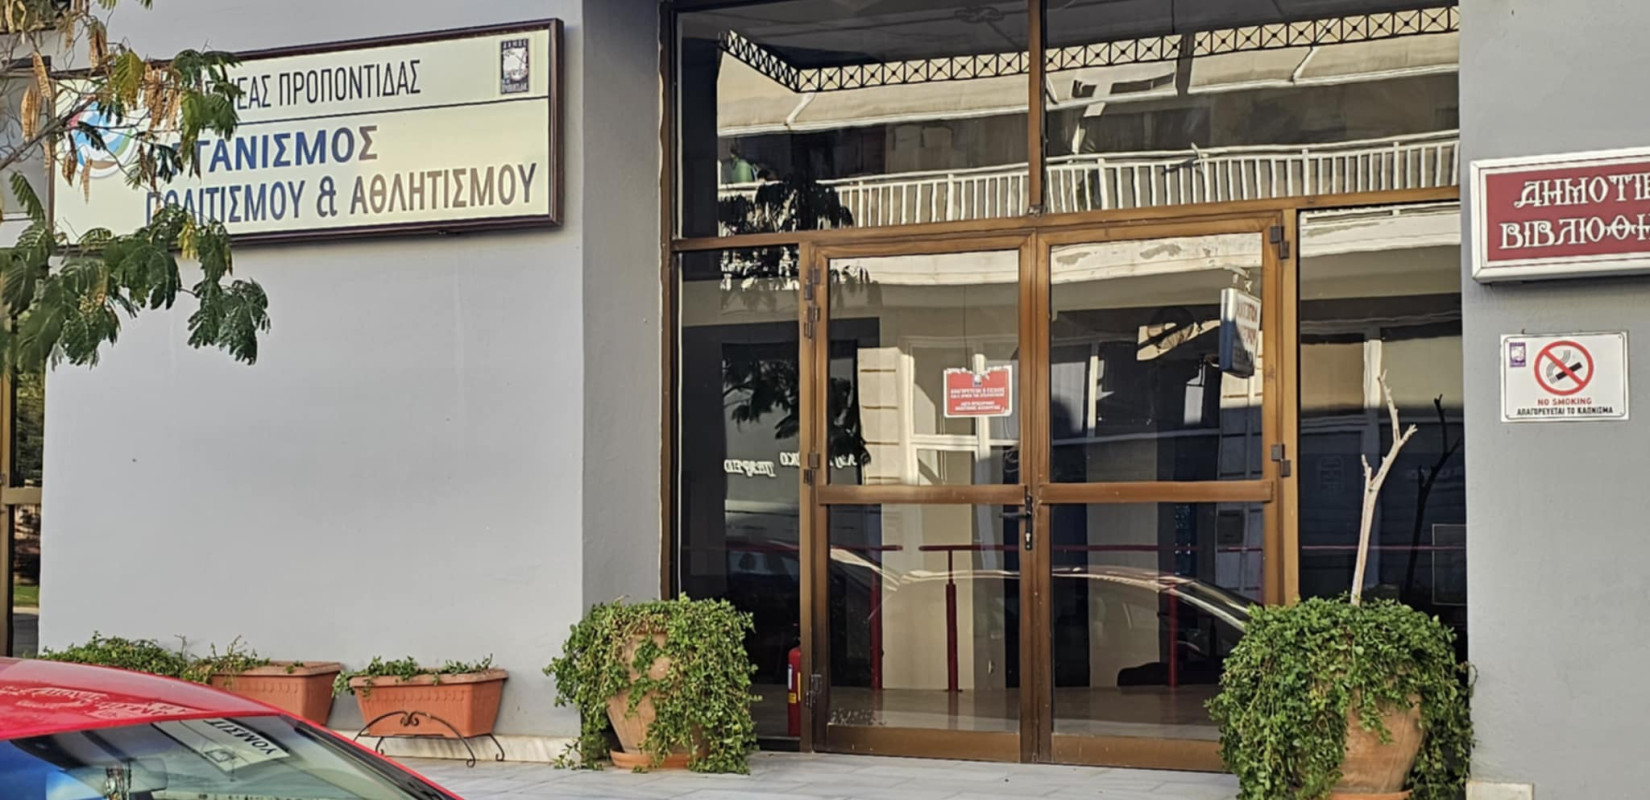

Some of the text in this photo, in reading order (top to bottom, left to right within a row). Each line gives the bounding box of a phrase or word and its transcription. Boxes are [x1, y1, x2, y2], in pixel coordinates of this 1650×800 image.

[230, 74, 272, 111] ΕΑΣ
[279, 59, 421, 106] ΠΡΟΠΟΝΤΙΔΑΣ
[170, 125, 378, 177] ΓΑΝΙΣΜΟΣ
[316, 175, 338, 218] &
[349, 162, 537, 215] ΑΘΛΗΤΙΣΜΟΥ
[1516, 407, 1565, 416] ΑΠΑΓΟΡΕΥΕΤΑΙ
[1577, 406, 1613, 415] ΚΑΠΝΙΣΜΑ
[1552, 397, 1592, 406] SMOKING
